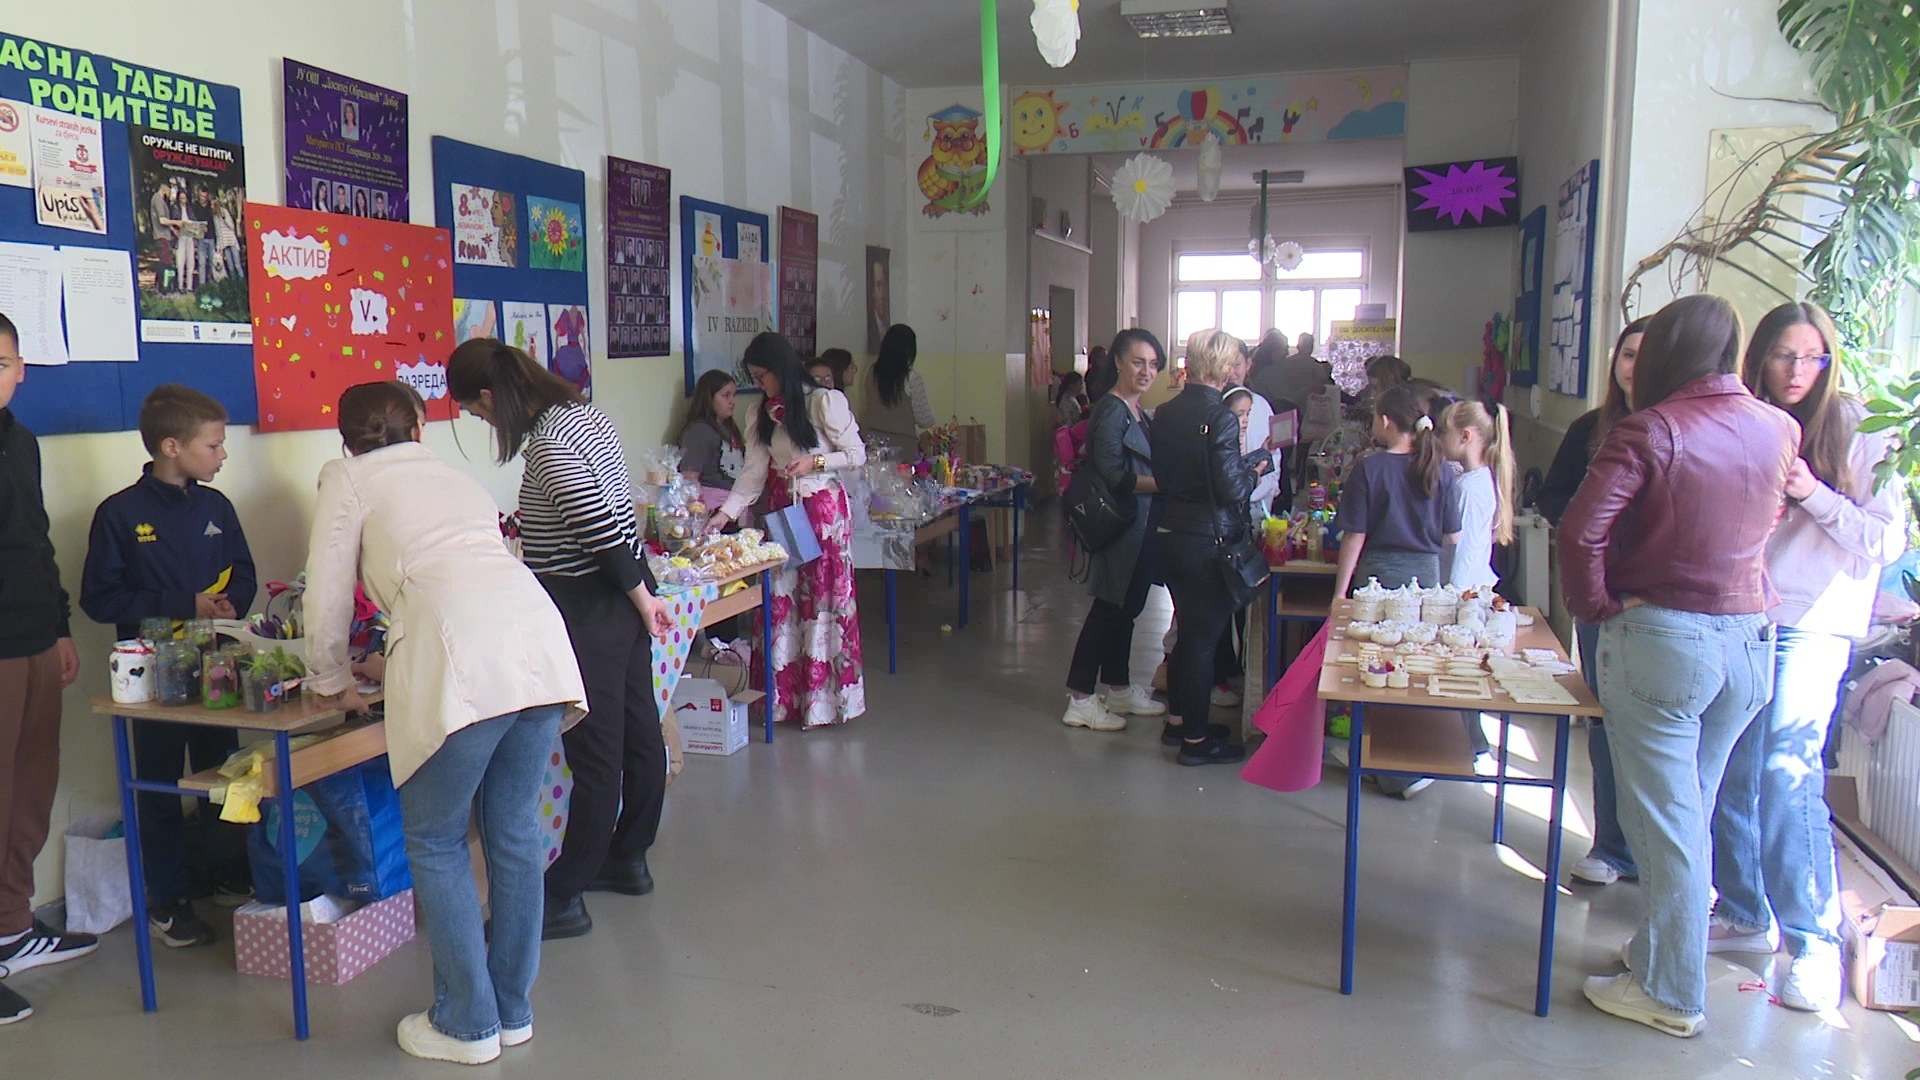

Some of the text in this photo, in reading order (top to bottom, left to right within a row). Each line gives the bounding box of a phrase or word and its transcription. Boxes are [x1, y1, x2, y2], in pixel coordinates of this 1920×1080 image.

[0, 38, 216, 110] АСНА ТАБЛА
[28, 78, 215, 139] РОДИТЕЉЕ
[142, 135, 235, 164] ОРУЖЈЕ НЕ ШТИТИ,
[42, 192, 80, 219] Upis
[269, 245, 328, 269] АКТИВ
[708, 316, 759, 332] IV RAZRED
